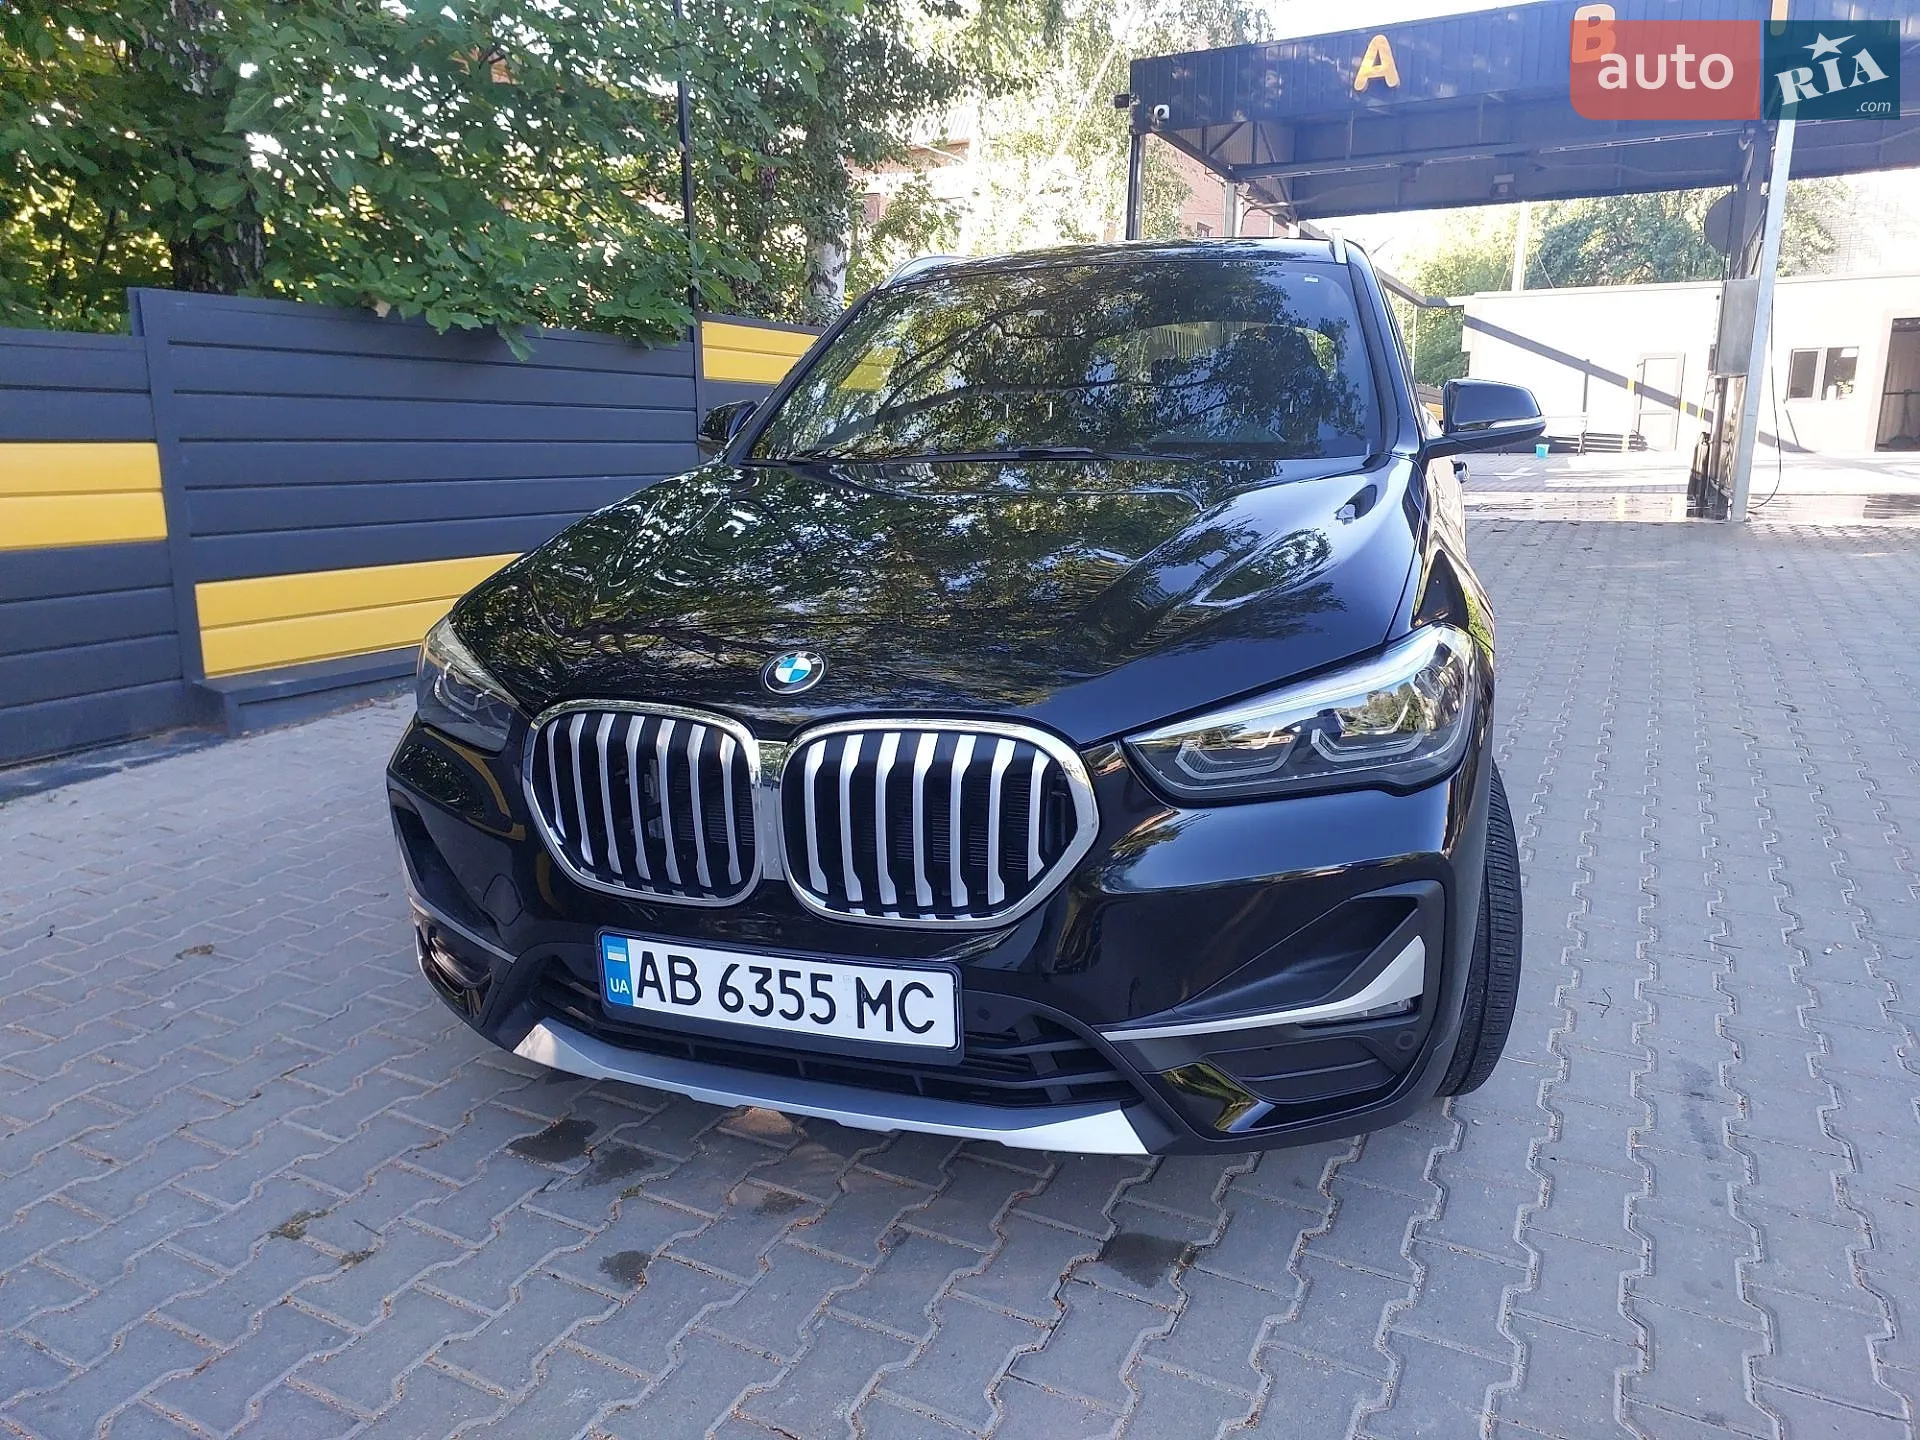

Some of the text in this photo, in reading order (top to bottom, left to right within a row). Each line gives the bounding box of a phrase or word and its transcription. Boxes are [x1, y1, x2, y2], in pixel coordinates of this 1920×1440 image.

[610, 977, 630, 995] UA
[637, 950, 935, 1034] AB 6355 MC
